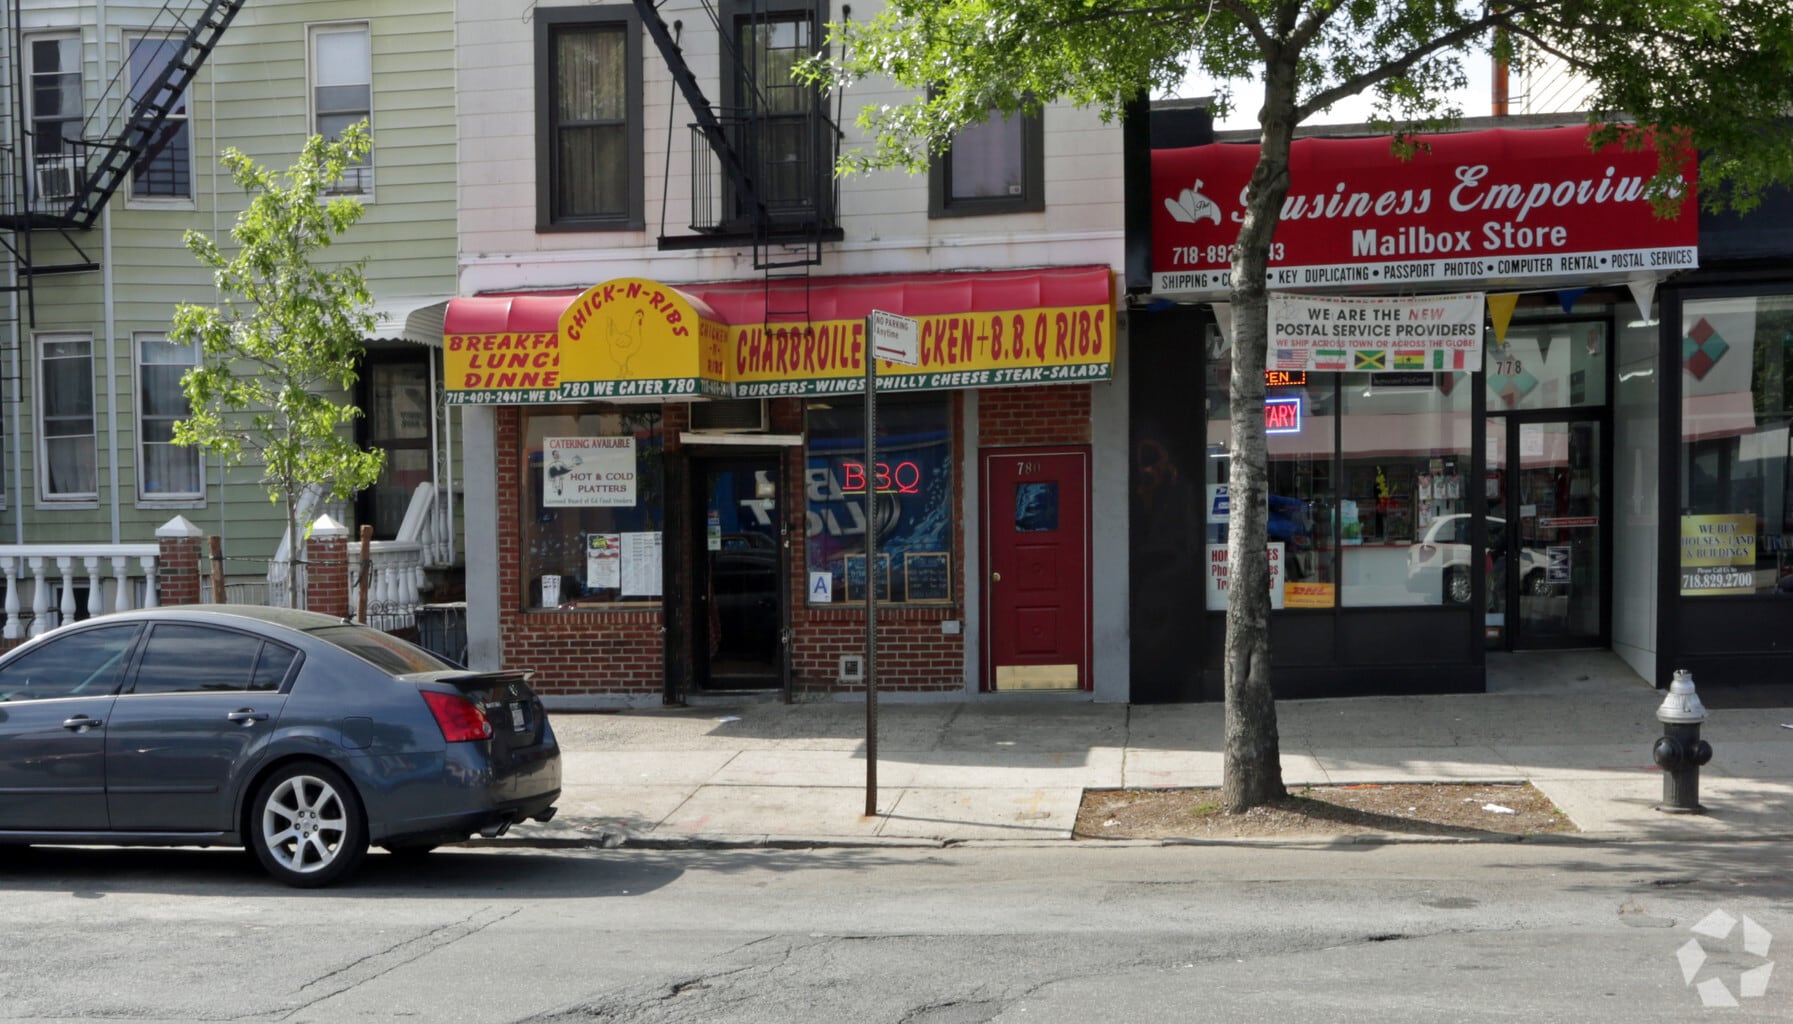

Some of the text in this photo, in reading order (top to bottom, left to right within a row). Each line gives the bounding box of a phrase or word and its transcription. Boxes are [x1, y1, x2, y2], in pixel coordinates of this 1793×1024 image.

[1352, 221, 1568, 257] Mailbox Store
[1162, 274, 1208, 289] SHIPPING
[1278, 269, 1298, 284] KEY
[1304, 266, 1369, 283] DUPLICATING
[1384, 263, 1436, 279] PASSPORT
[1444, 261, 1484, 276] PHOTOS
[1498, 258, 1553, 274] COMPUTER
[1561, 255, 1599, 271] RENTAL
[1611, 252, 1644, 268] POSTAL
[1650, 249, 1693, 266] SERVICES
[567, 282, 689, 341] CHICK-N-RIBS
[1307, 307, 1446, 321] WE ARE THE NEW
[876, 316, 909, 331] NO PARKING
[1275, 323, 1477, 336] POSTAL SERVICE PROVIDERS
[449, 333, 559, 352] BREAKFA
[736, 323, 863, 375] CHARBROILE
[1056, 308, 1105, 361] RIBS
[1276, 339, 1289, 347] WE
[1290, 339, 1309, 347] SHIP
[1312, 339, 1346, 348] ACROSS
[1348, 339, 1373, 348] TOWN
[1375, 339, 1388, 348] OR
[1391, 339, 1426, 348] ACROSS
[1429, 339, 1443, 347] THE
[931, 371, 990, 387] CHEESE
[994, 363, 1109, 383] STEAK-SALADS
[1496, 359, 1522, 375] 778
[464, 371, 560, 388] DINNE
[562, 382, 590, 397] 780
[593, 381, 615, 396] WE
[618, 379, 663, 395] CATER
[667, 378, 696, 394] 780
[549, 438, 630, 449] CATERING AVAILABLE
[570, 472, 592, 481] HOT
[605, 472, 634, 481] COLD
[842, 461, 920, 494] BBQ
[577, 484, 627, 493] PLATTERS
[1699, 523, 1738, 534] WE BUY
[1681, 536, 1720, 546] HOUSES
[1696, 548, 1749, 559] BUILDINGS
[814, 576, 828, 594] A
[1683, 573, 1753, 589] 718.829.2700
[1293, 586, 1328, 596] DHL
